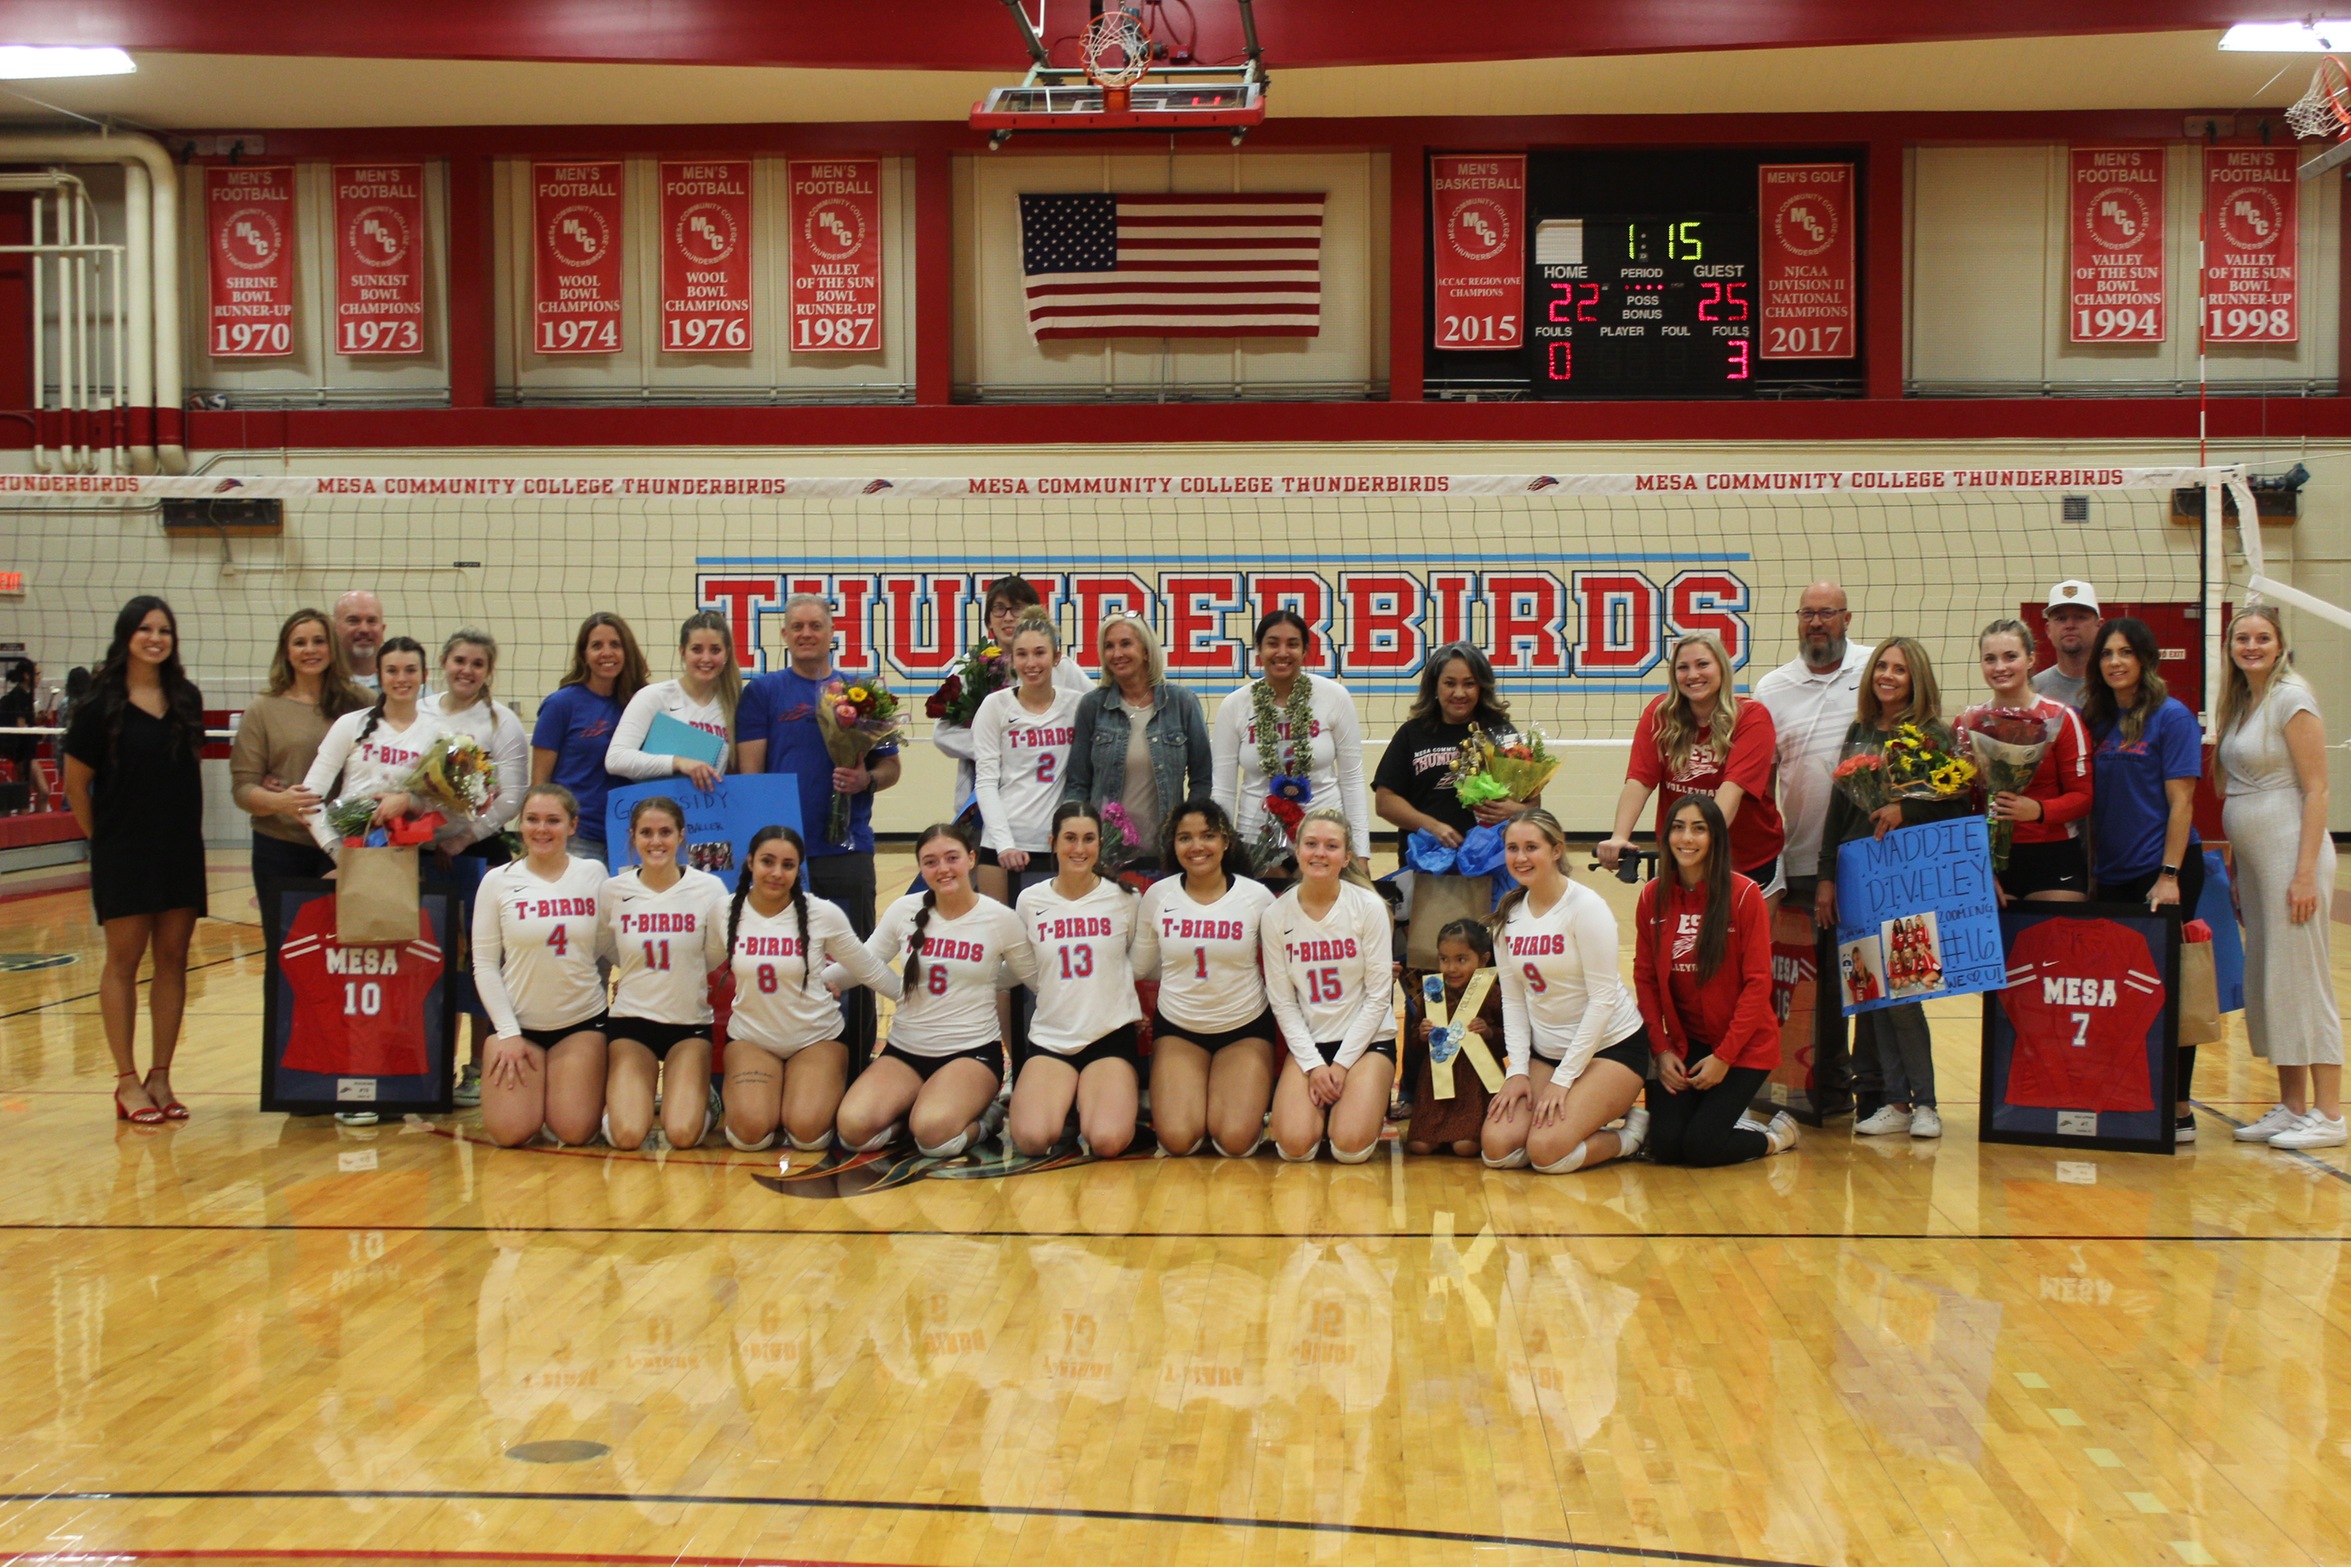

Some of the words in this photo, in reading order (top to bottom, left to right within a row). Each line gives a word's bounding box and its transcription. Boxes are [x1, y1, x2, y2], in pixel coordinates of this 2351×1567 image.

[2094, 153, 2140, 166] MEN'S
[2228, 153, 2274, 166] MEN'S
[356, 170, 400, 182] MEN'S
[556, 168, 600, 181] MEN'S
[683, 166, 728, 179] MEN'S
[812, 166, 856, 178] MEN'S
[1458, 164, 1498, 175] MEN'S
[1767, 172, 1807, 183] MEN'S
[1811, 171, 1846, 183] GOLF
[2078, 170, 2157, 182] FOOTBALL
[2211, 169, 2291, 182] FOOTBALL
[228, 172, 272, 185] MEN'S
[1436, 178, 1521, 190] BASKETBALL
[213, 187, 288, 200] FOOTBALL
[340, 185, 416, 198] FOOTBALL
[540, 183, 616, 197] FOOTBALL
[668, 182, 744, 195] FOOTBALL
[796, 182, 872, 194] FOOTBALL
[681, 203, 721, 221] COMMUNITY
[721, 210, 737, 242] COLLEGE
[1453, 198, 1494, 216] COMMUNITY
[1494, 205, 1510, 239] COLLEGE
[1791, 208, 1824, 241] MCC
[2102, 201, 2135, 235] MCC
[2235, 201, 2268, 235] MCC
[364, 220, 396, 253] MCC
[563, 219, 596, 252] MCC
[691, 217, 723, 250] MCC
[820, 213, 852, 246] MCC
[1463, 212, 1497, 246] MCC
[236, 222, 268, 255] MCC
[681, 247, 733, 265] THUNDERBIRDS
[1453, 243, 1506, 260] THUNDERBIRDS
[2093, 255, 2142, 266] VALLEY
[2225, 255, 2275, 266] VALLEY
[812, 264, 859, 275] VALLEY
[1544, 267, 1588, 279] HOME
[1621, 268, 1663, 278] PERIOD
[1694, 265, 1744, 277] GUEST
[1784, 267, 1828, 277] NJCAA
[2077, 268, 2096, 279] OF
[2098, 268, 2127, 278] THE
[2130, 267, 2158, 278] SUN
[2209, 268, 2228, 279] OF
[2231, 268, 2259, 278] THE
[2263, 267, 2291, 278] SUN
[227, 277, 278, 288] SHRINE
[352, 275, 408, 286] SUNKIST
[559, 275, 601, 287] WOOL
[686, 272, 728, 283] WOOL
[797, 278, 814, 288] OF
[817, 277, 844, 288] THE
[848, 277, 874, 288] SUN
[1438, 278, 1467, 286] ACCAC
[1469, 278, 1501, 286] REGION
[1503, 277, 1521, 285] ONE
[1769, 280, 1830, 290] DIVISION
[1831, 279, 1845, 290] II
[361, 288, 400, 300] BOWL
[560, 288, 600, 299] BOWL
[687, 286, 728, 297] BOWL
[1450, 289, 1503, 297] CHAMPIONS
[2097, 281, 2138, 292] BOWL
[2230, 281, 2271, 292] BOWL
[232, 291, 273, 302] BOWL
[816, 290, 856, 302] BOWL
[1549, 283, 1599, 322] 22
[1627, 296, 1659, 305] POSS
[1698, 283, 1748, 321] 25
[1772, 293, 1841, 304] NATIONAL
[2075, 293, 2161, 305] CHAMPIONS
[2209, 293, 2292, 305] RUNNER-UP
[215, 305, 292, 317] RUNNER-UP
[340, 302, 421, 314] CHAMPIONS
[539, 300, 620, 312] CHAMPIONS
[665, 300, 748, 311] CHAMPIONS
[797, 304, 876, 315] RUNNER-UP
[1766, 306, 1848, 317] CHAMPIONS
[1622, 310, 1663, 319] BONUS
[1444, 316, 1516, 342] 2015
[2078, 309, 2157, 337] 1994
[2210, 309, 2290, 337] 1998
[216, 323, 290, 351] 1970
[344, 321, 418, 349] 1973
[542, 320, 617, 348] 1974
[669, 318, 746, 346] 1976
[798, 318, 874, 346] 1987
[1535, 327, 1572, 336] FOULS
[1601, 327, 1644, 336] PLAYER
[1661, 327, 1691, 336] FOUL
[1713, 326, 1749, 336] FOULS
[1770, 327, 1843, 353] 2017
[1549, 342, 1571, 380] 0
[1727, 341, 1749, 379] 3
[317, 479, 376, 494] MESA
[385, 479, 516, 494] COMMUNITY
[524, 480, 614, 494] COLLEGE
[623, 479, 786, 495] THUNDERBIRDS
[969, 478, 1030, 494] MESA
[1038, 478, 1172, 494] COMMUNITY
[1181, 477, 1273, 493] COLLEGE
[1282, 476, 1449, 493] THUNDERBIRDS
[1636, 474, 1697, 491] MESA
[1706, 473, 1842, 490] COMMUNITY
[1852, 471, 1945, 488] COLLEGE
[1953, 469, 2124, 487] THUNDERBIRDS
[1008, 727, 1076, 748] T-BIRDS
[362, 743, 420, 766] T-BIR
[1037, 752, 1056, 783] 2
[1666, 782, 1718, 797] VOLLEYBA
[1866, 821, 1982, 871] MADDIE
[1867, 856, 1988, 912] DIVELEY
[515, 898, 595, 920] T-BIRDS
[1938, 904, 1994, 924] ZOOMING
[621, 914, 696, 933] T-BIRDS
[1038, 917, 1111, 942] T-BIRDS
[1162, 918, 1243, 940] T-BIRDS
[546, 923, 568, 956] 4
[643, 939, 671, 970] 11
[906, 935, 984, 962] TBIRDS
[1286, 939, 1357, 963] T-BIRDS
[1940, 927, 1995, 968] #16
[325, 948, 398, 975] MESA
[1058, 944, 1094, 980] 13
[1194, 946, 1207, 979] 1
[757, 963, 778, 994] 8
[928, 964, 949, 996] 6
[1523, 962, 1546, 994] 9
[1946, 975, 1967, 988] WE
[1985, 967, 2001, 981] U!
[1306, 967, 1342, 1004] 15
[2043, 977, 2117, 1007] MESA
[343, 981, 381, 1016] 10
[1776, 988, 1790, 1020] 16
[2071, 1012, 2090, 1046] 7
